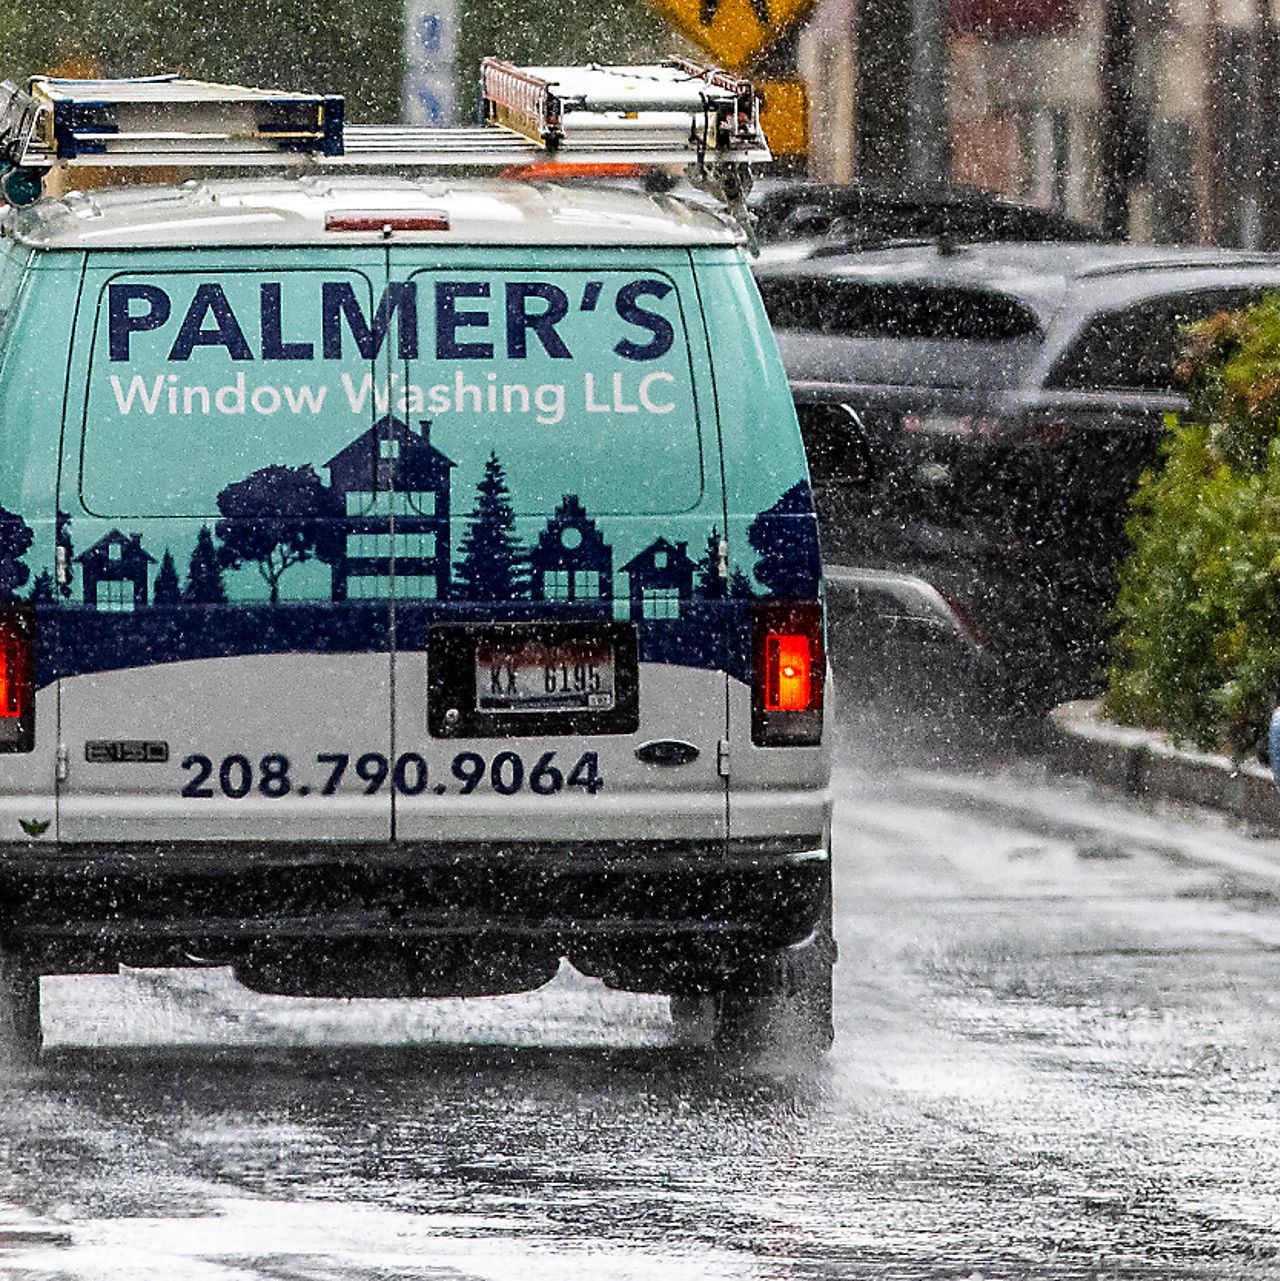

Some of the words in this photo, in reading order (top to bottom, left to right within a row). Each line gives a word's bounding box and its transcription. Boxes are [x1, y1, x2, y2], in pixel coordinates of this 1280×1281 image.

[108, 279, 675, 361] PALMER'S
[110, 372, 327, 415] Window
[341, 371, 565, 424] Washing
[584, 372, 675, 412] LLC
[181, 751, 605, 799] 208.790.9064
